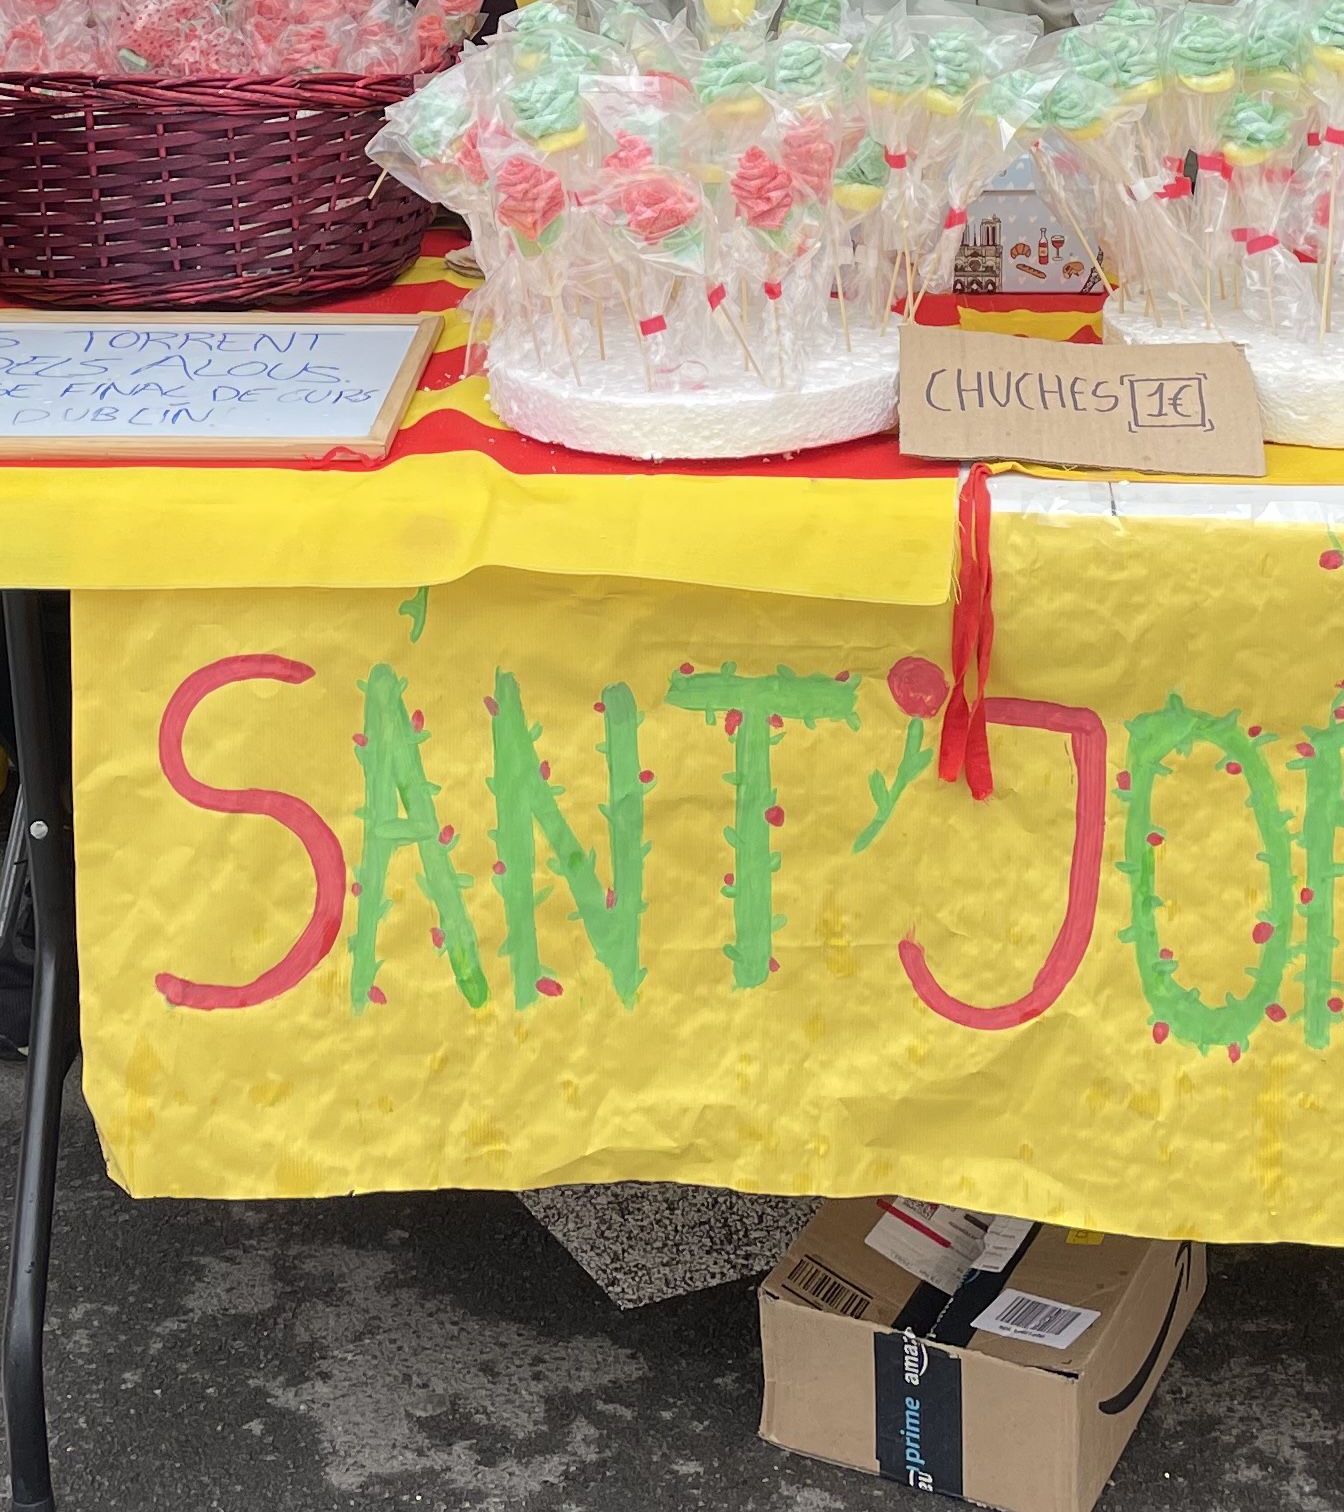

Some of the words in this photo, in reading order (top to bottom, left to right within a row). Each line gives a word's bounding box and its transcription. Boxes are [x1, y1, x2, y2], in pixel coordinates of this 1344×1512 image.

[63, 329, 345, 354] TORRENT
[59, 381, 192, 401] FINAL
[211, 385, 278, 403] DE
[277, 388, 381, 405] CURS
[925, 368, 1120, 413] CHUCHES
[1145, 381, 1193, 418] 1€
[154, 653, 865, 1017] SANT
[900, 1396, 926, 1466] prime
